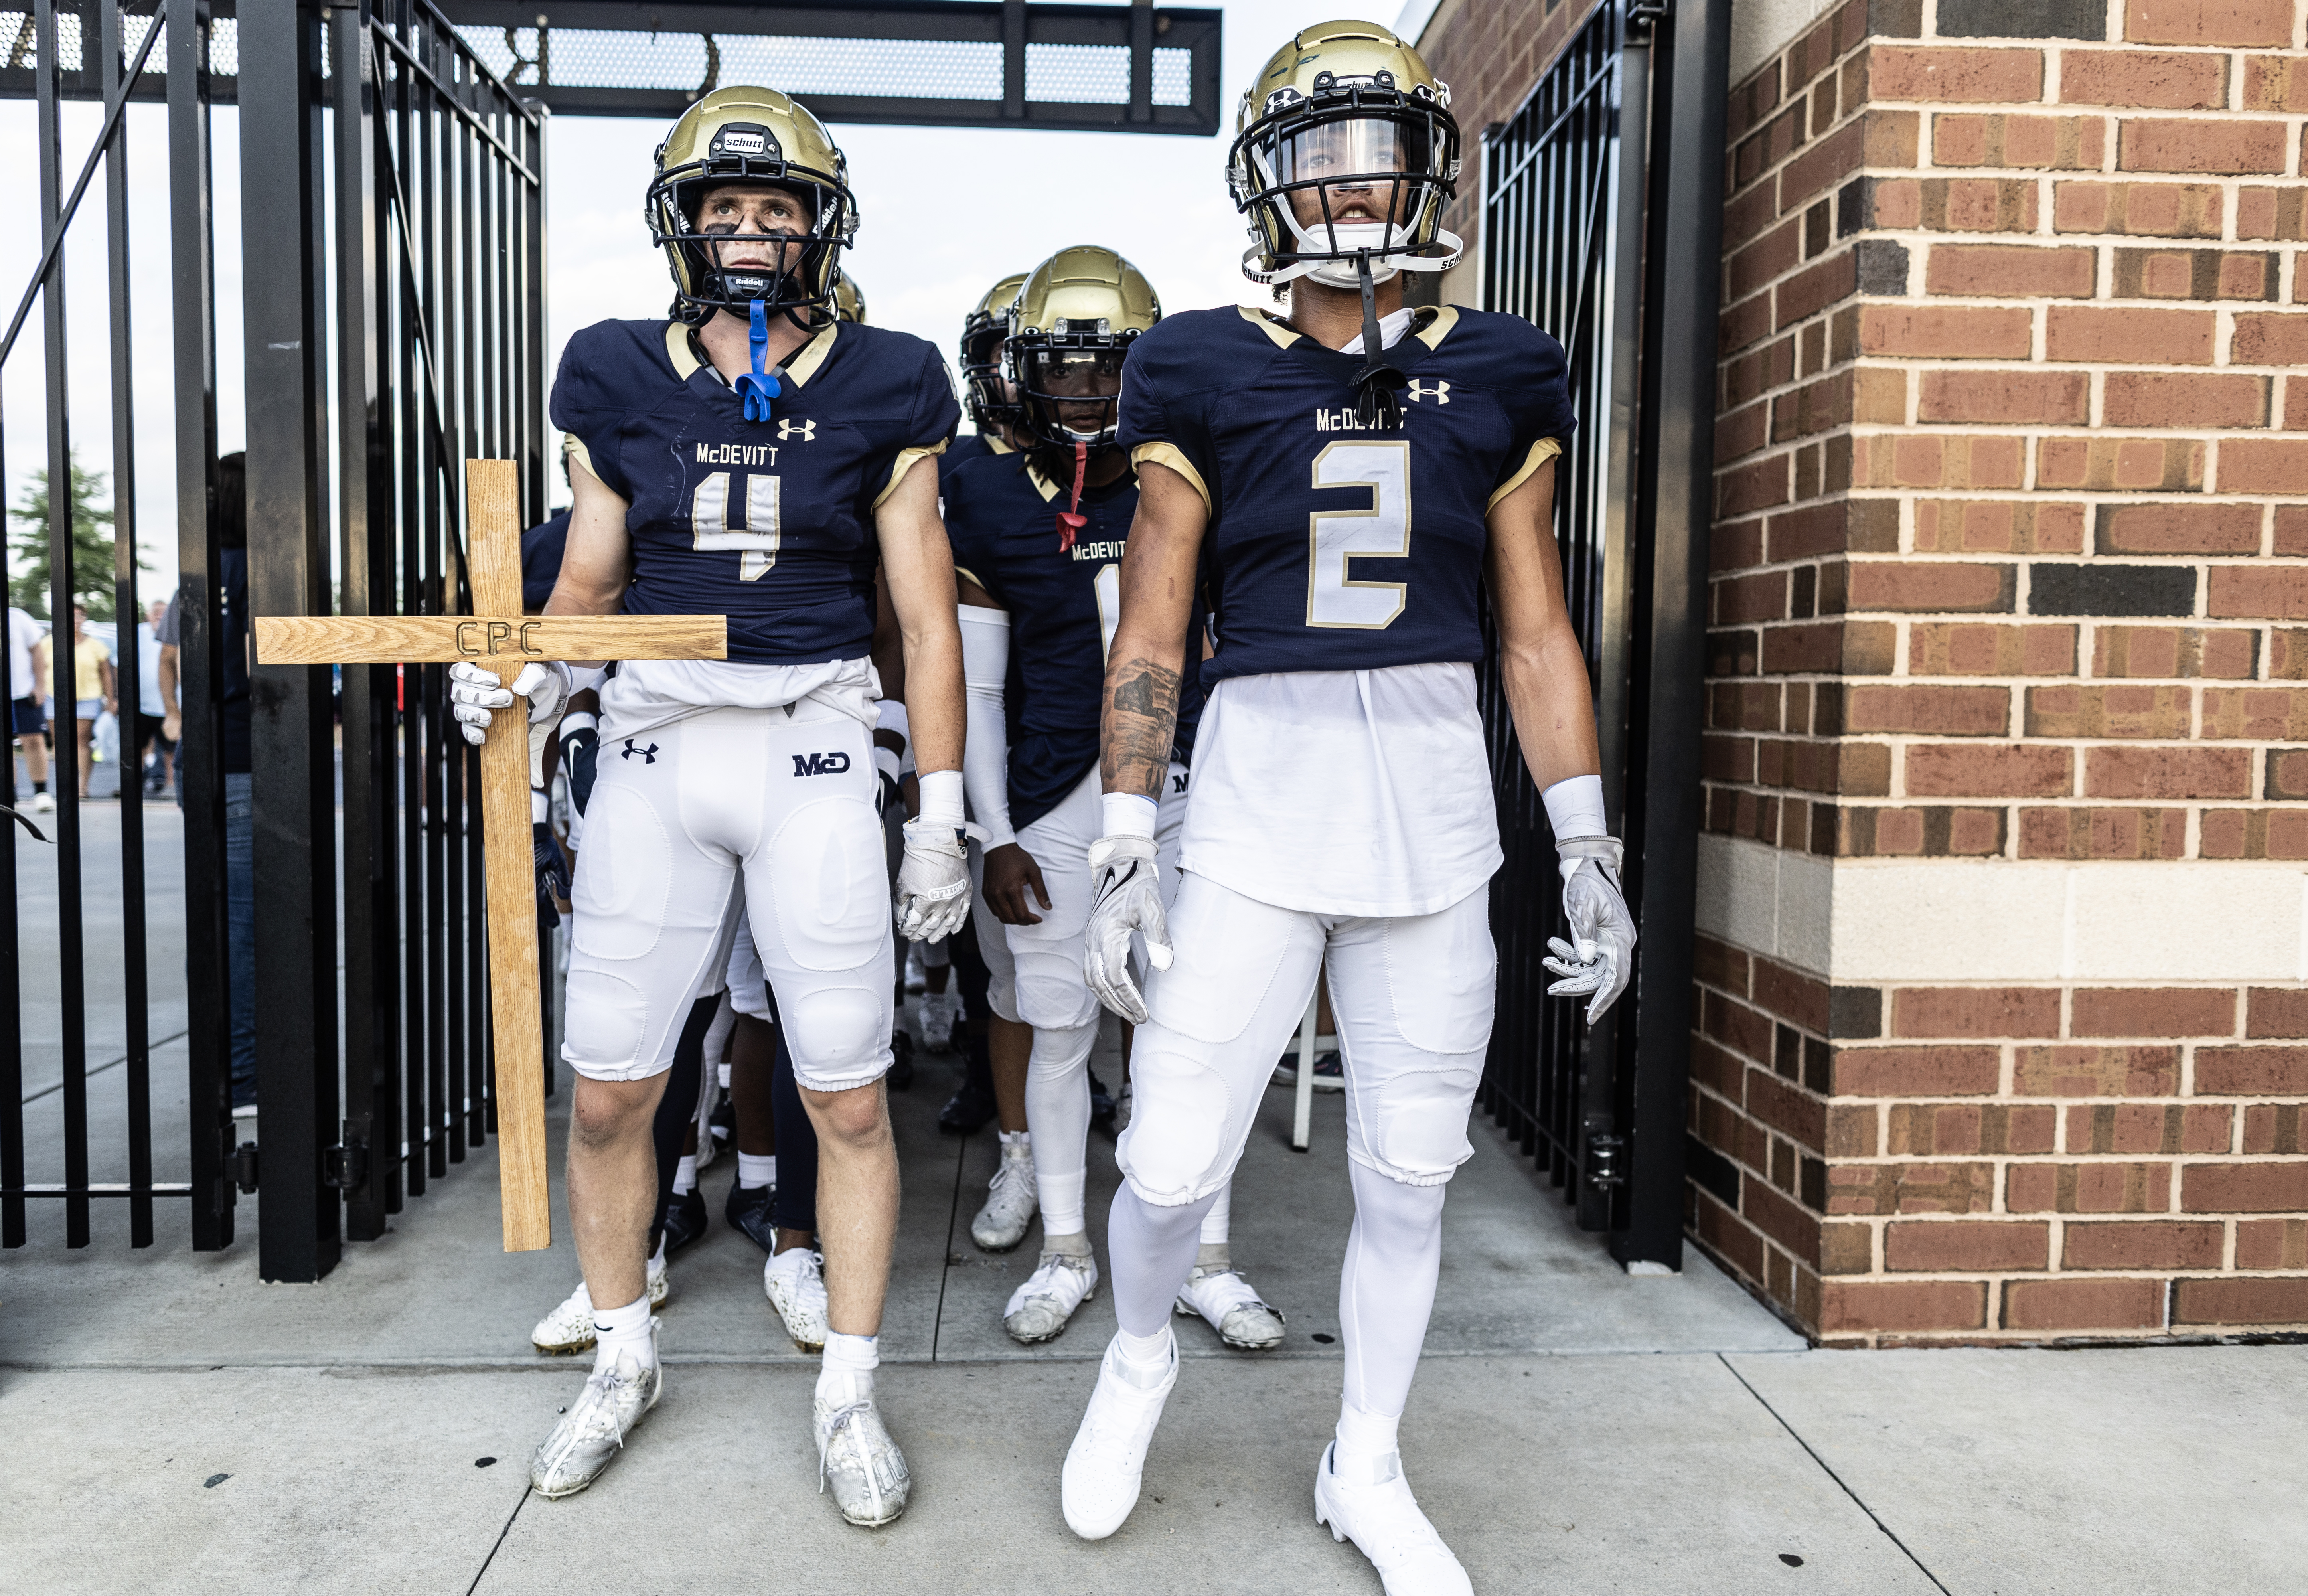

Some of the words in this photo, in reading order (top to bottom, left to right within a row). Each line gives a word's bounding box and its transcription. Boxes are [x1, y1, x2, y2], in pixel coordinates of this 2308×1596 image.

[726, 138, 762, 148] schutt
[1242, 266, 1272, 284] chutt
[697, 442, 778, 466] McDEVITT
[692, 472, 780, 581] 4
[1306, 440, 1411, 630] 2
[456, 622, 542, 655] CPC
[932, 881, 964, 899] BATTLE
